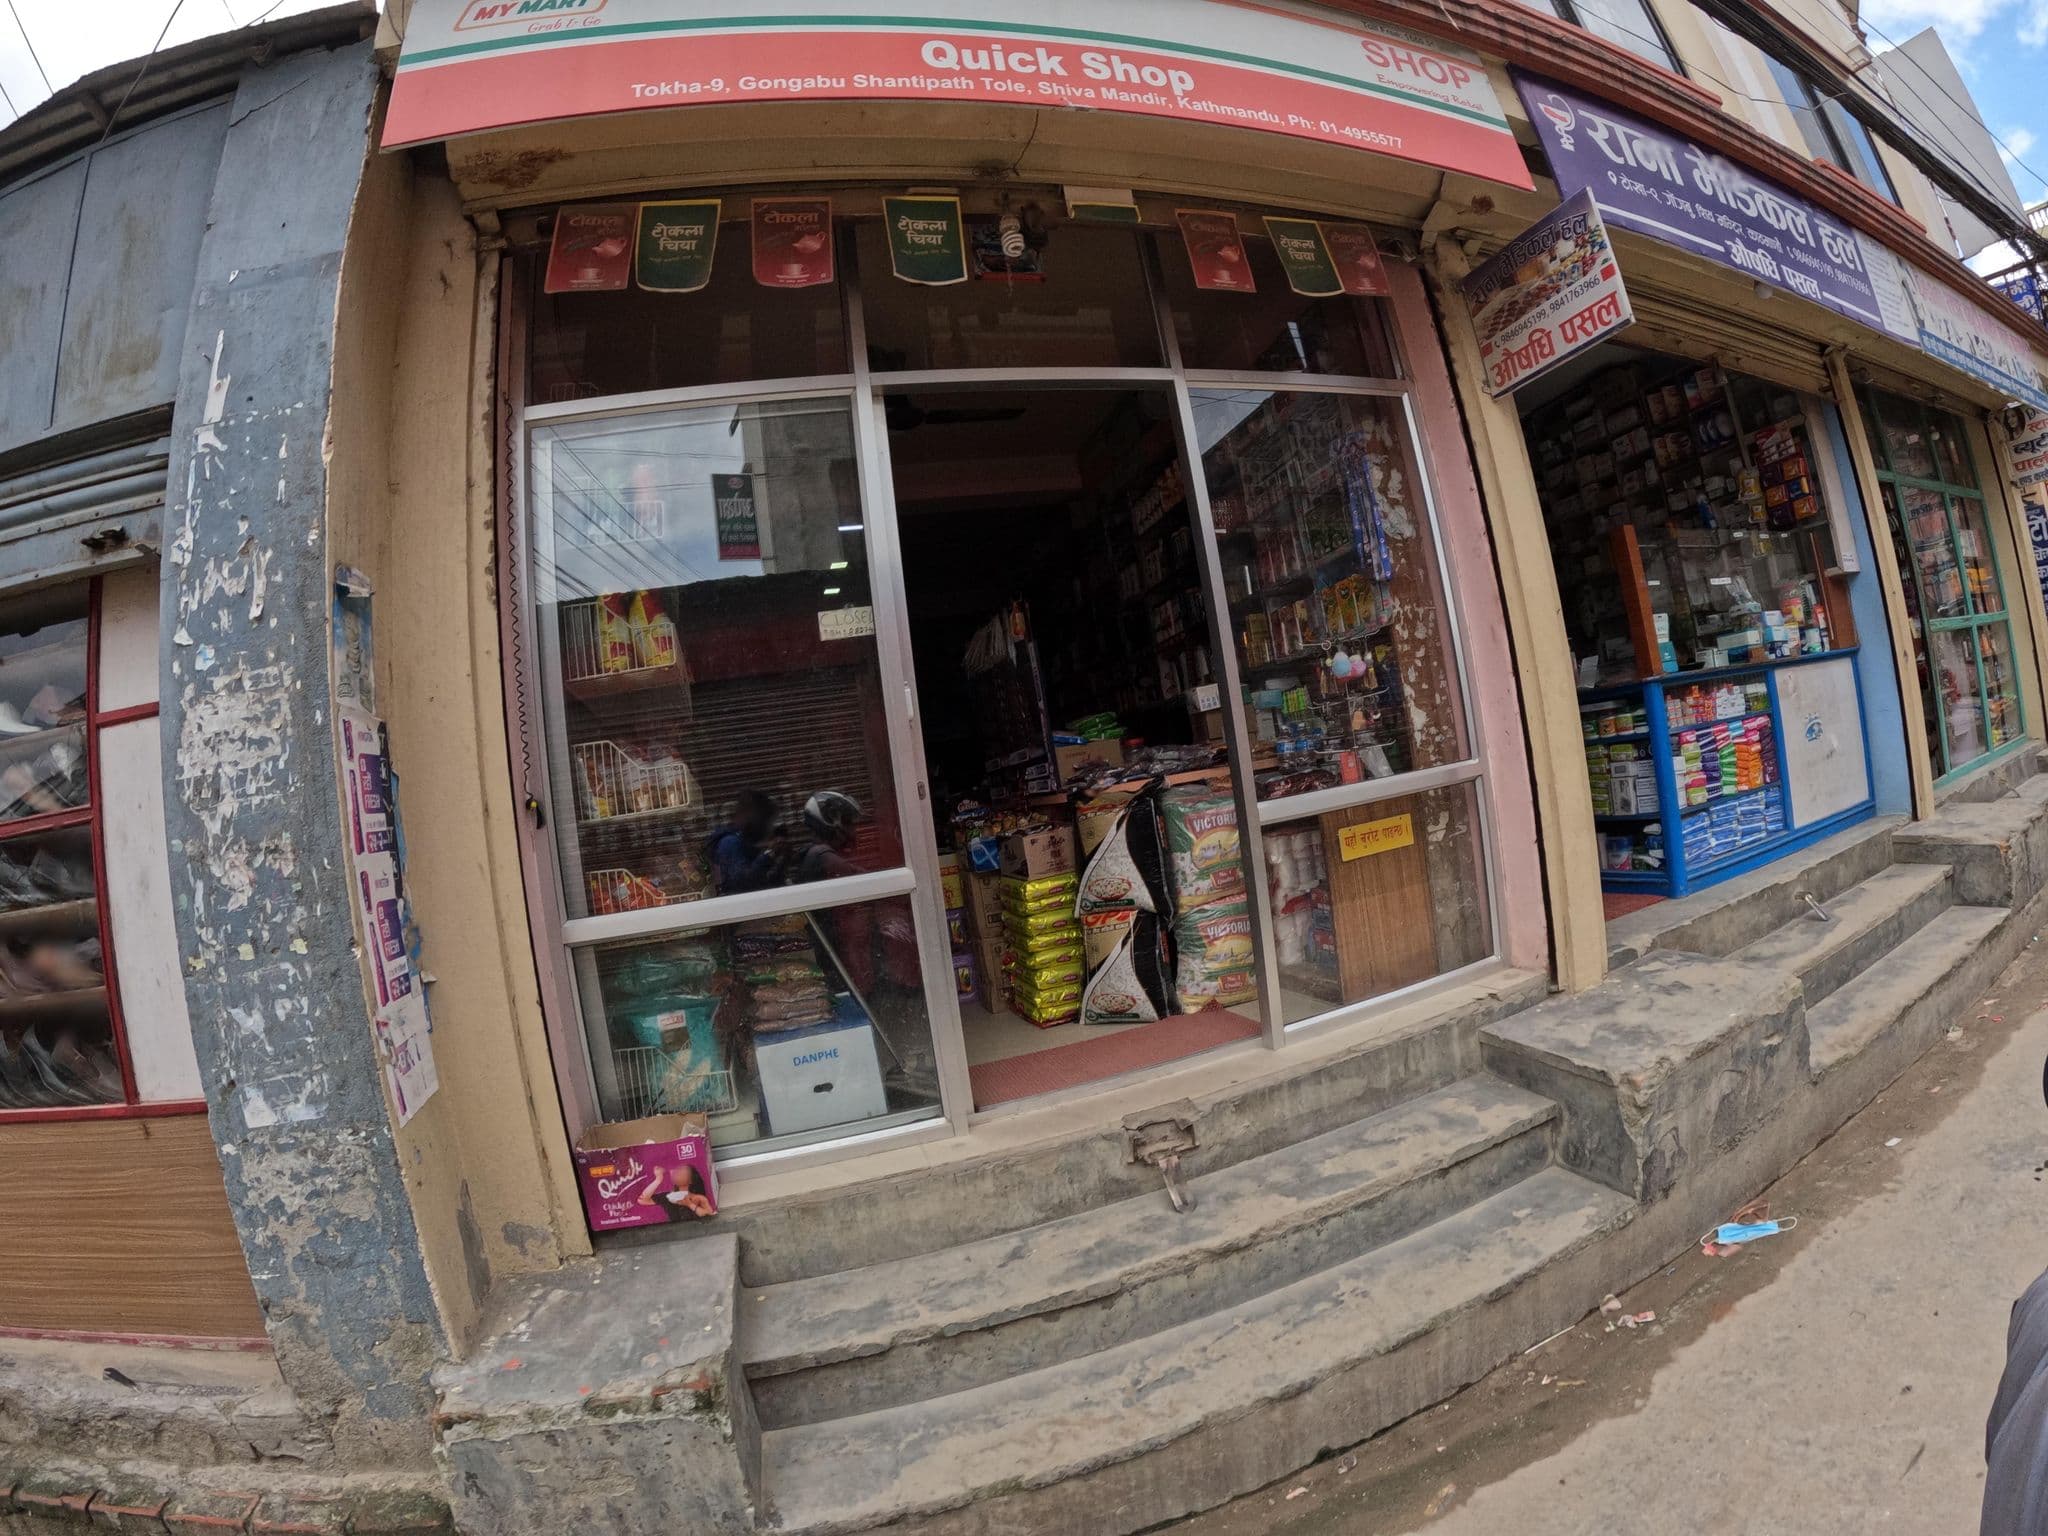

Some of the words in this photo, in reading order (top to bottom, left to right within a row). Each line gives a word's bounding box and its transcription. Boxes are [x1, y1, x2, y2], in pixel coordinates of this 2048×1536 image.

[474, 2, 518, 20] MY
[528, 19, 562, 33] Grab
[583, 16, 601, 27] Go
[921, 40, 1068, 77] Quick
[1080, 51, 1194, 96] Shop
[1361, 40, 1470, 89] SHOP
[632, 78, 730, 98] Tokha-9,
[738, 74, 846, 92] Gongabu
[853, 74, 974, 91] Shantipath
[980, 77, 1032, 96] Tole,
[1038, 81, 1095, 99] Shiva
[1101, 87, 1174, 110] Mandir,
[1178, 98, 1285, 127] Kathmandu,
[1289, 113, 1316, 131] Ph:
[1320, 119, 1402, 149] 01-4955577
[652, 223, 704, 237] टोकला
[897, 216, 948, 232] टोकला
[659, 239, 697, 252] चिया
[906, 233, 943, 246] चिया
[1813, 217, 1863, 273] हल
[1725, 237, 1781, 282] औषधि
[1781, 264, 1822, 300] पसल
[1549, 275, 1600, 315] 9841763966
[1490, 327, 1556, 388] औषधि
[1559, 290, 1623, 345] पसल
[793, 1048, 839, 1066] DANPHE
[680, 1144, 693, 1154] 30
[598, 1157, 644, 1200] Quick
